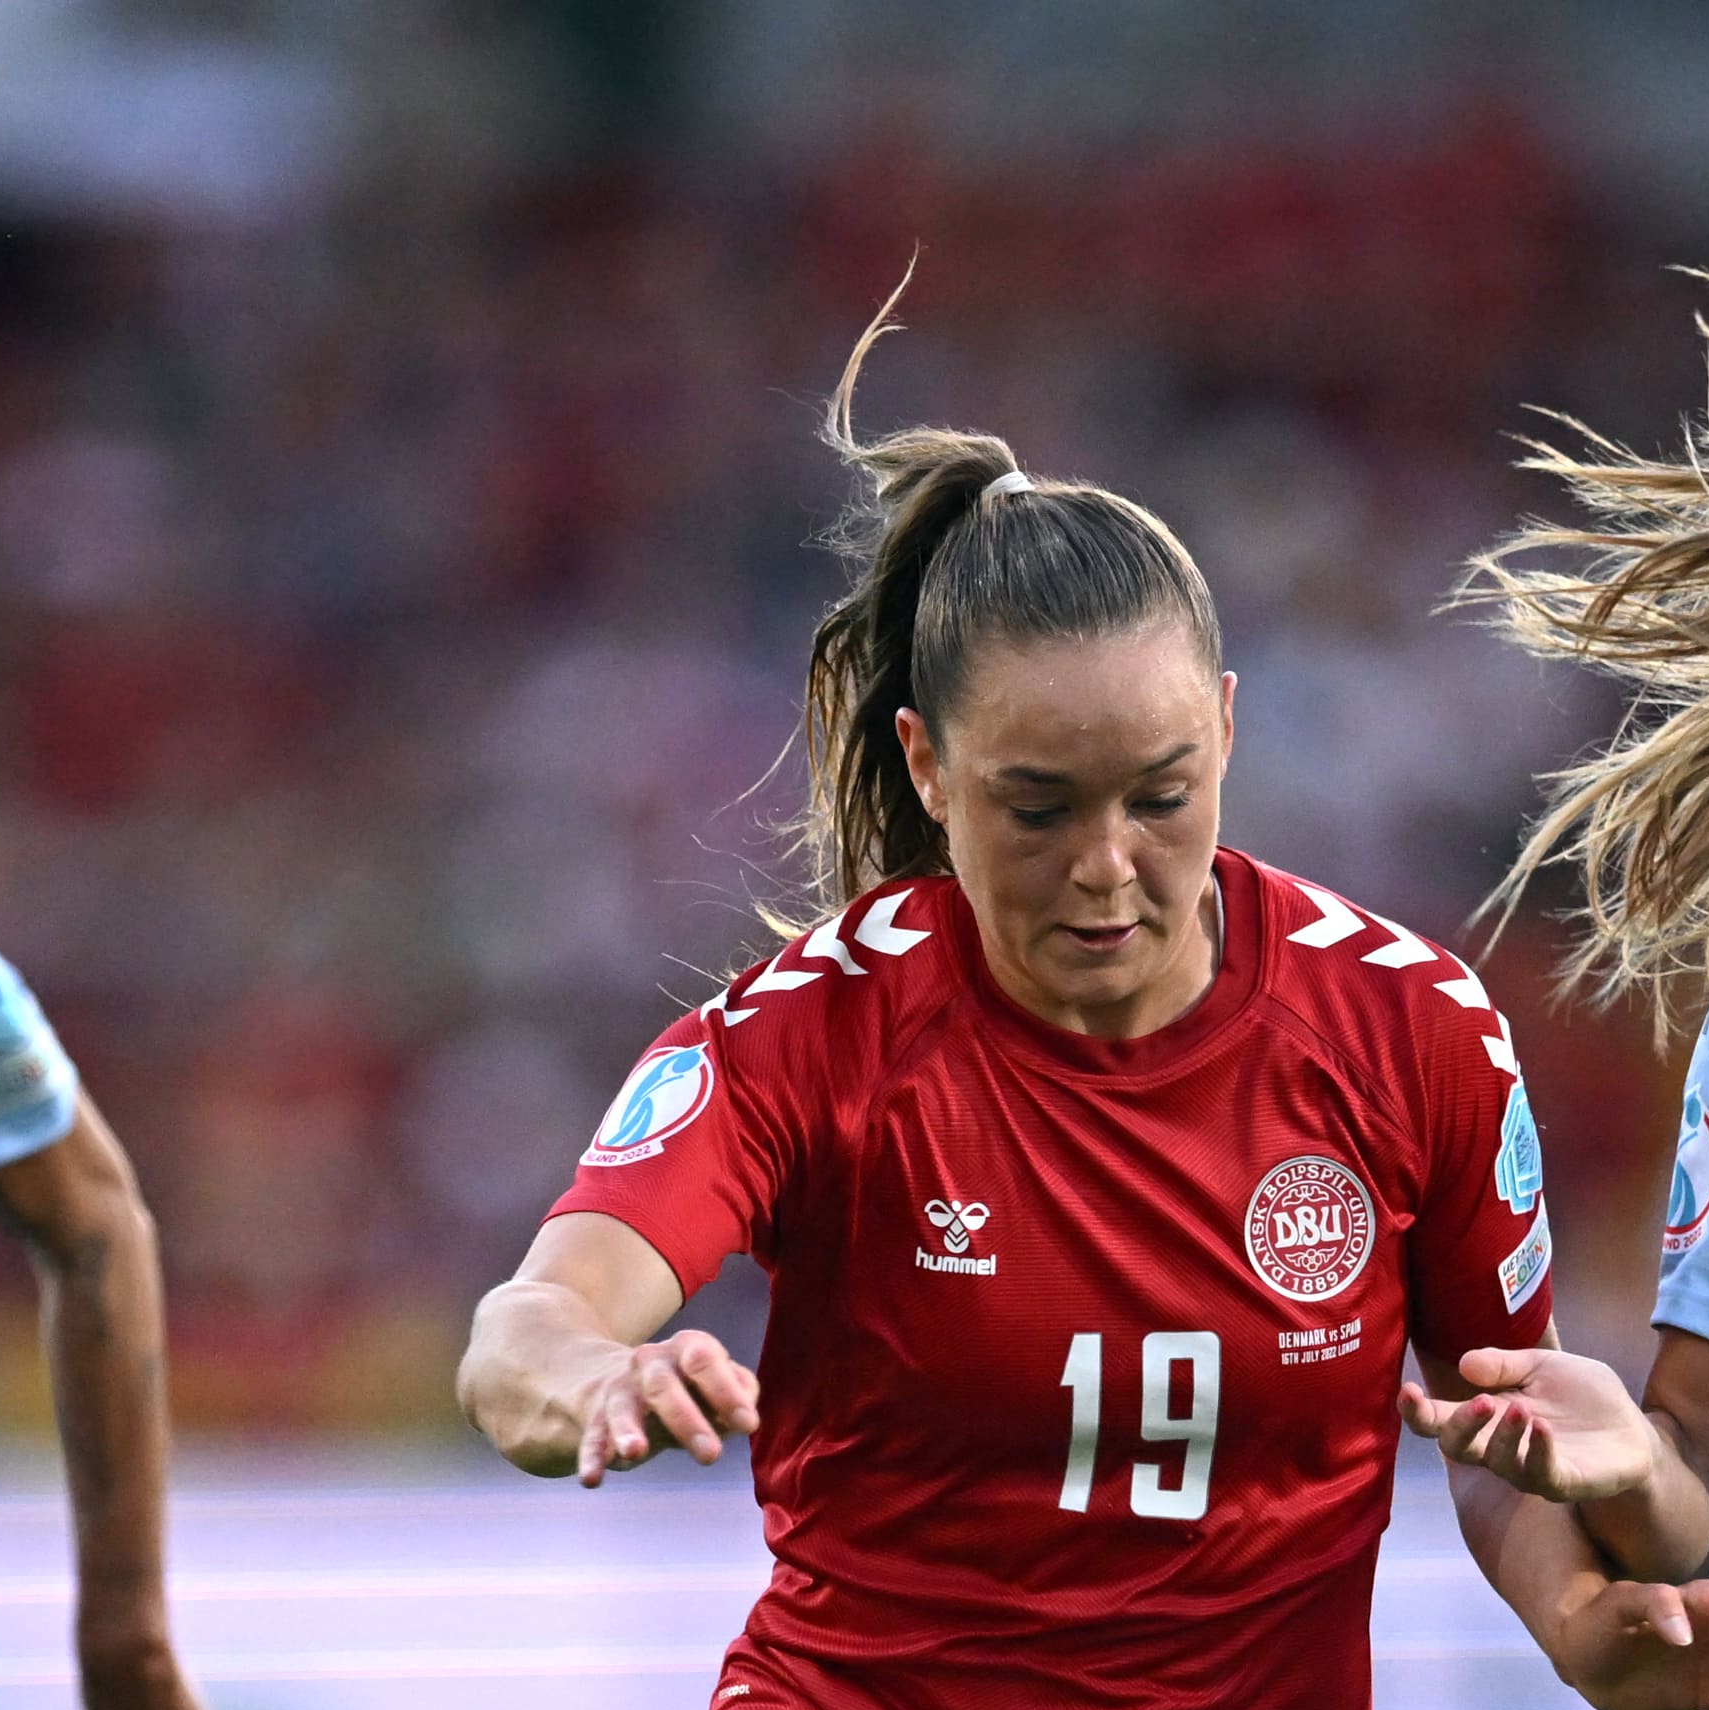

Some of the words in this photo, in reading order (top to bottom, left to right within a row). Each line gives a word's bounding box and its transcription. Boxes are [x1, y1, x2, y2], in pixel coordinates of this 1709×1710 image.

[620, 1145, 651, 1162] 2022
[1273, 1204, 1345, 1248] DBU
[1252, 1202, 1287, 1282] DANSK
[915, 1246, 996, 1276] hummel
[1291, 1270, 1340, 1294] 1889
[1278, 1328, 1327, 1349] DENMARK
[1301, 1350, 1319, 1364] JULY
[1057, 1330, 1221, 1520] 19
